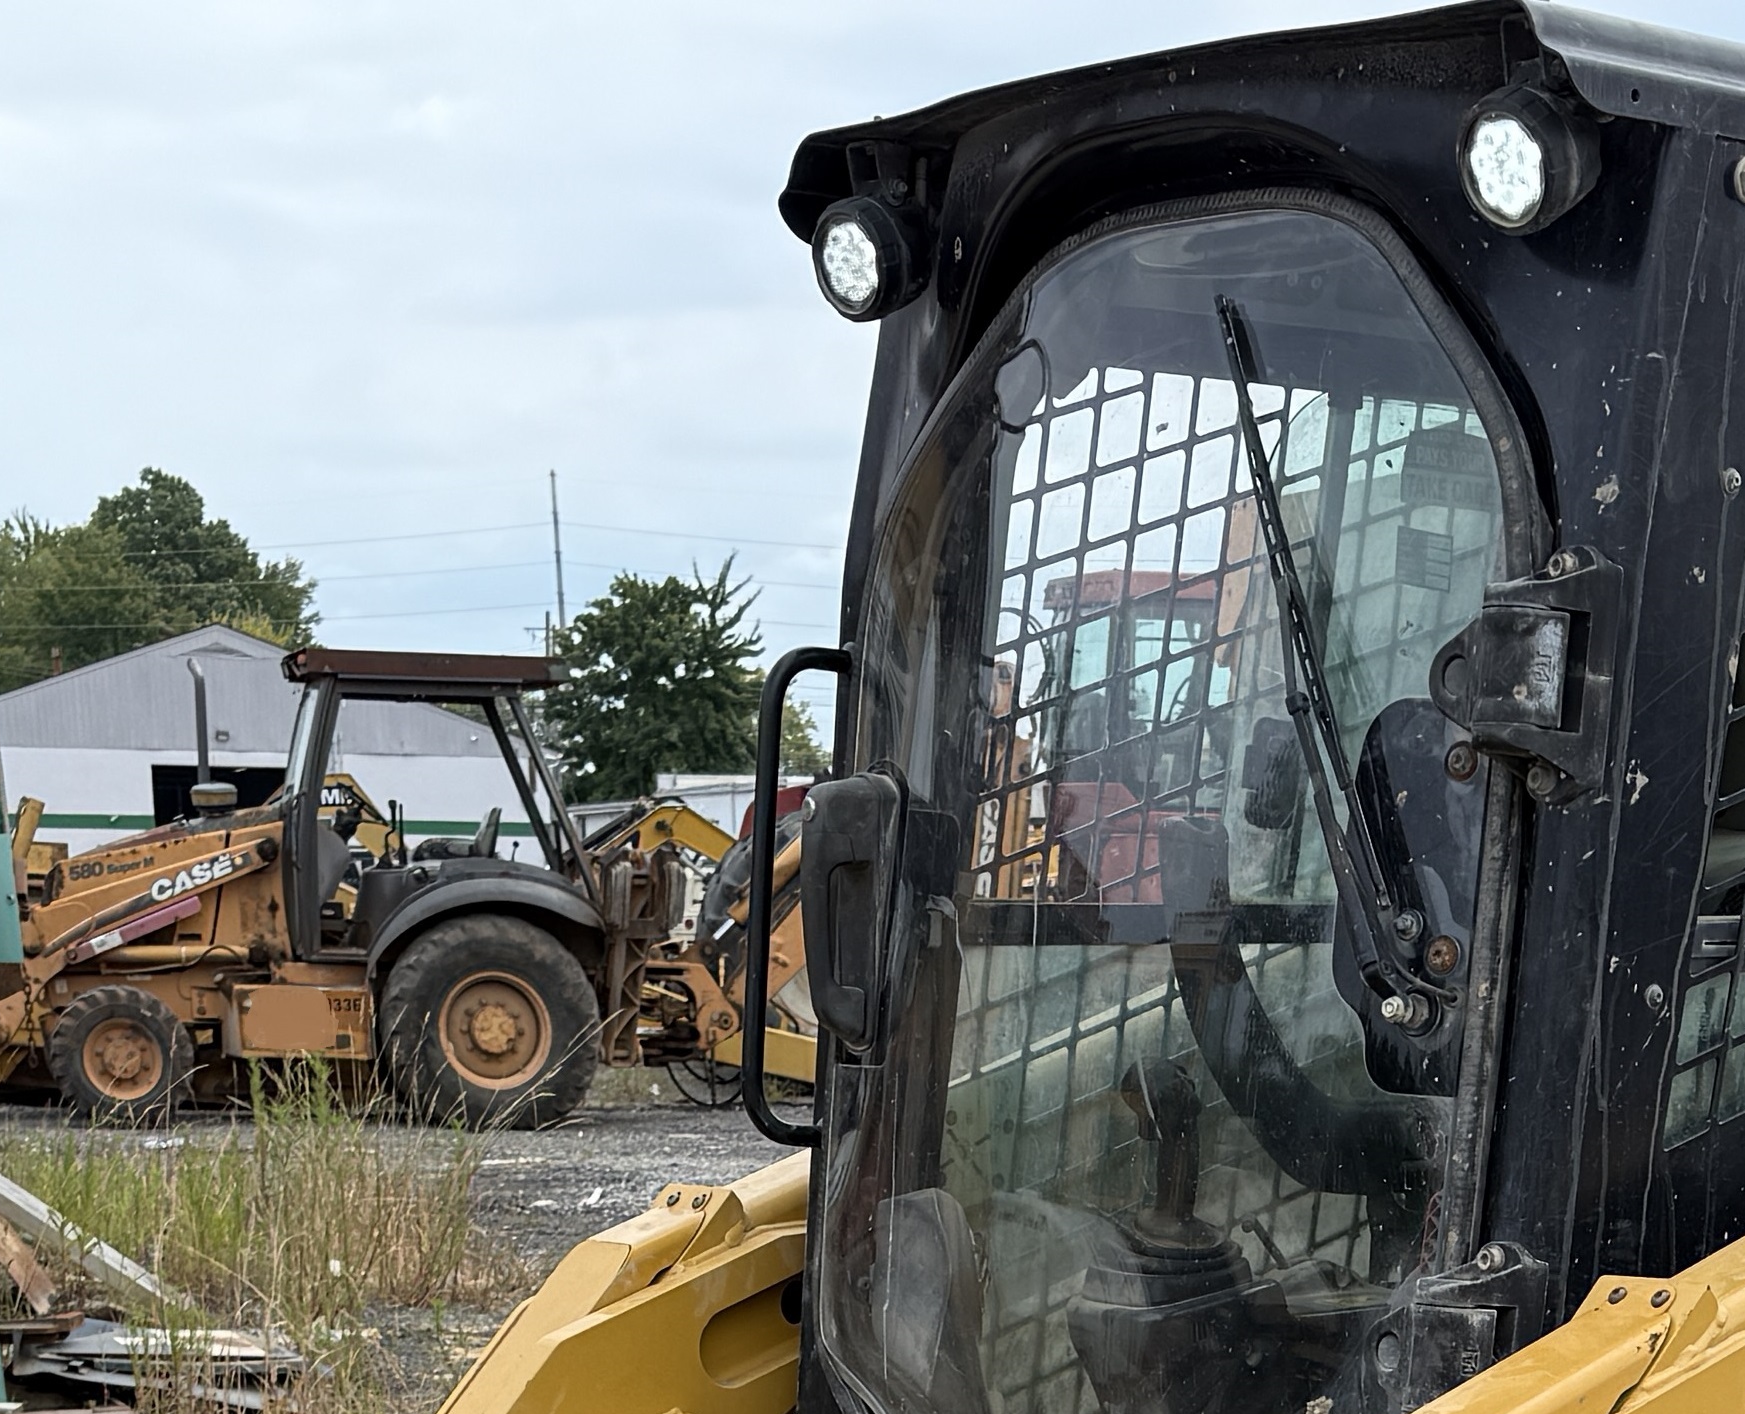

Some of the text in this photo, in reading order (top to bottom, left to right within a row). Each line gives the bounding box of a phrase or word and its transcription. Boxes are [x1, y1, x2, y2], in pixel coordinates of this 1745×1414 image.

[69, 861, 105, 881] 580
[107, 861, 142, 875] Super
[150, 853, 233, 901] CASE
